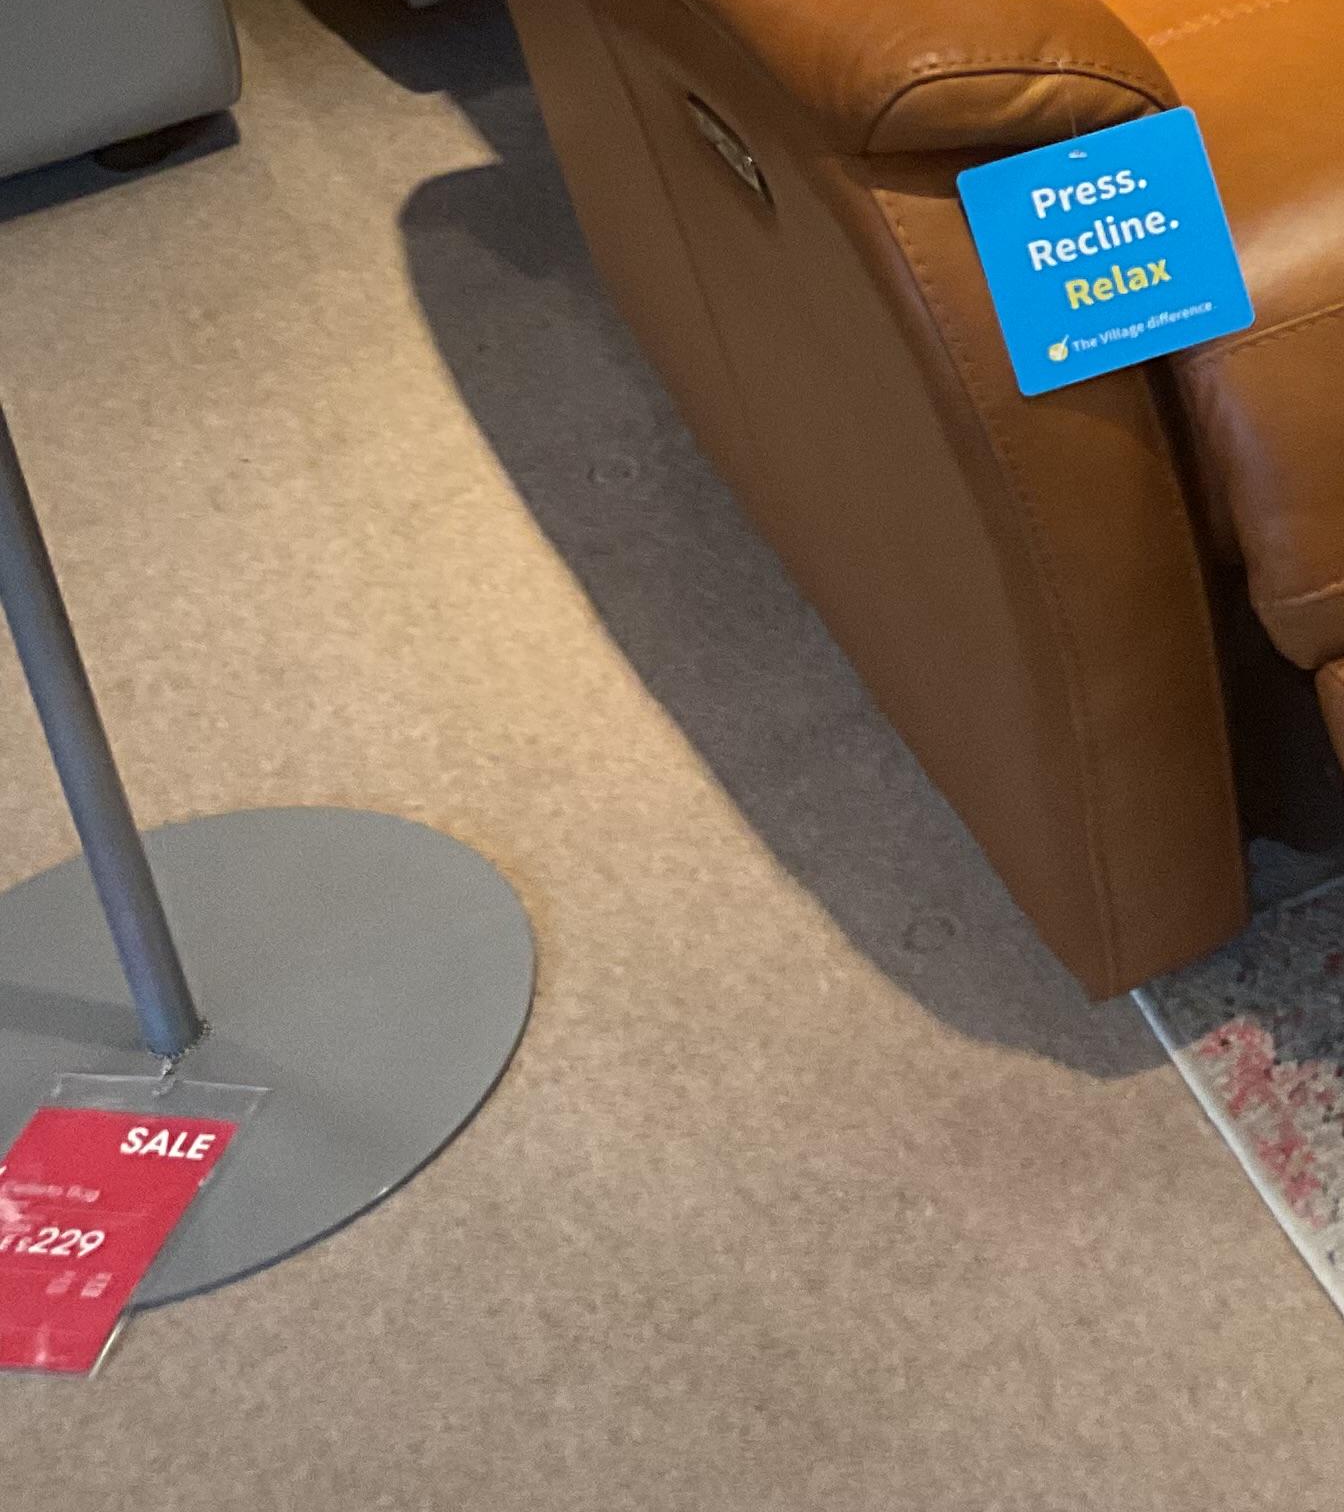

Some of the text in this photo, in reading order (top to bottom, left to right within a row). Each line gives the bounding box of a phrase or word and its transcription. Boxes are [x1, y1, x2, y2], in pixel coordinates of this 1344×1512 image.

[1031, 169, 1147, 219] Press.
[1027, 209, 1180, 271] Recline.
[1065, 258, 1172, 310] Relax
[1072, 337, 1098, 352] The
[1100, 322, 1145, 346] Village
[120, 1126, 216, 1161] SALE
